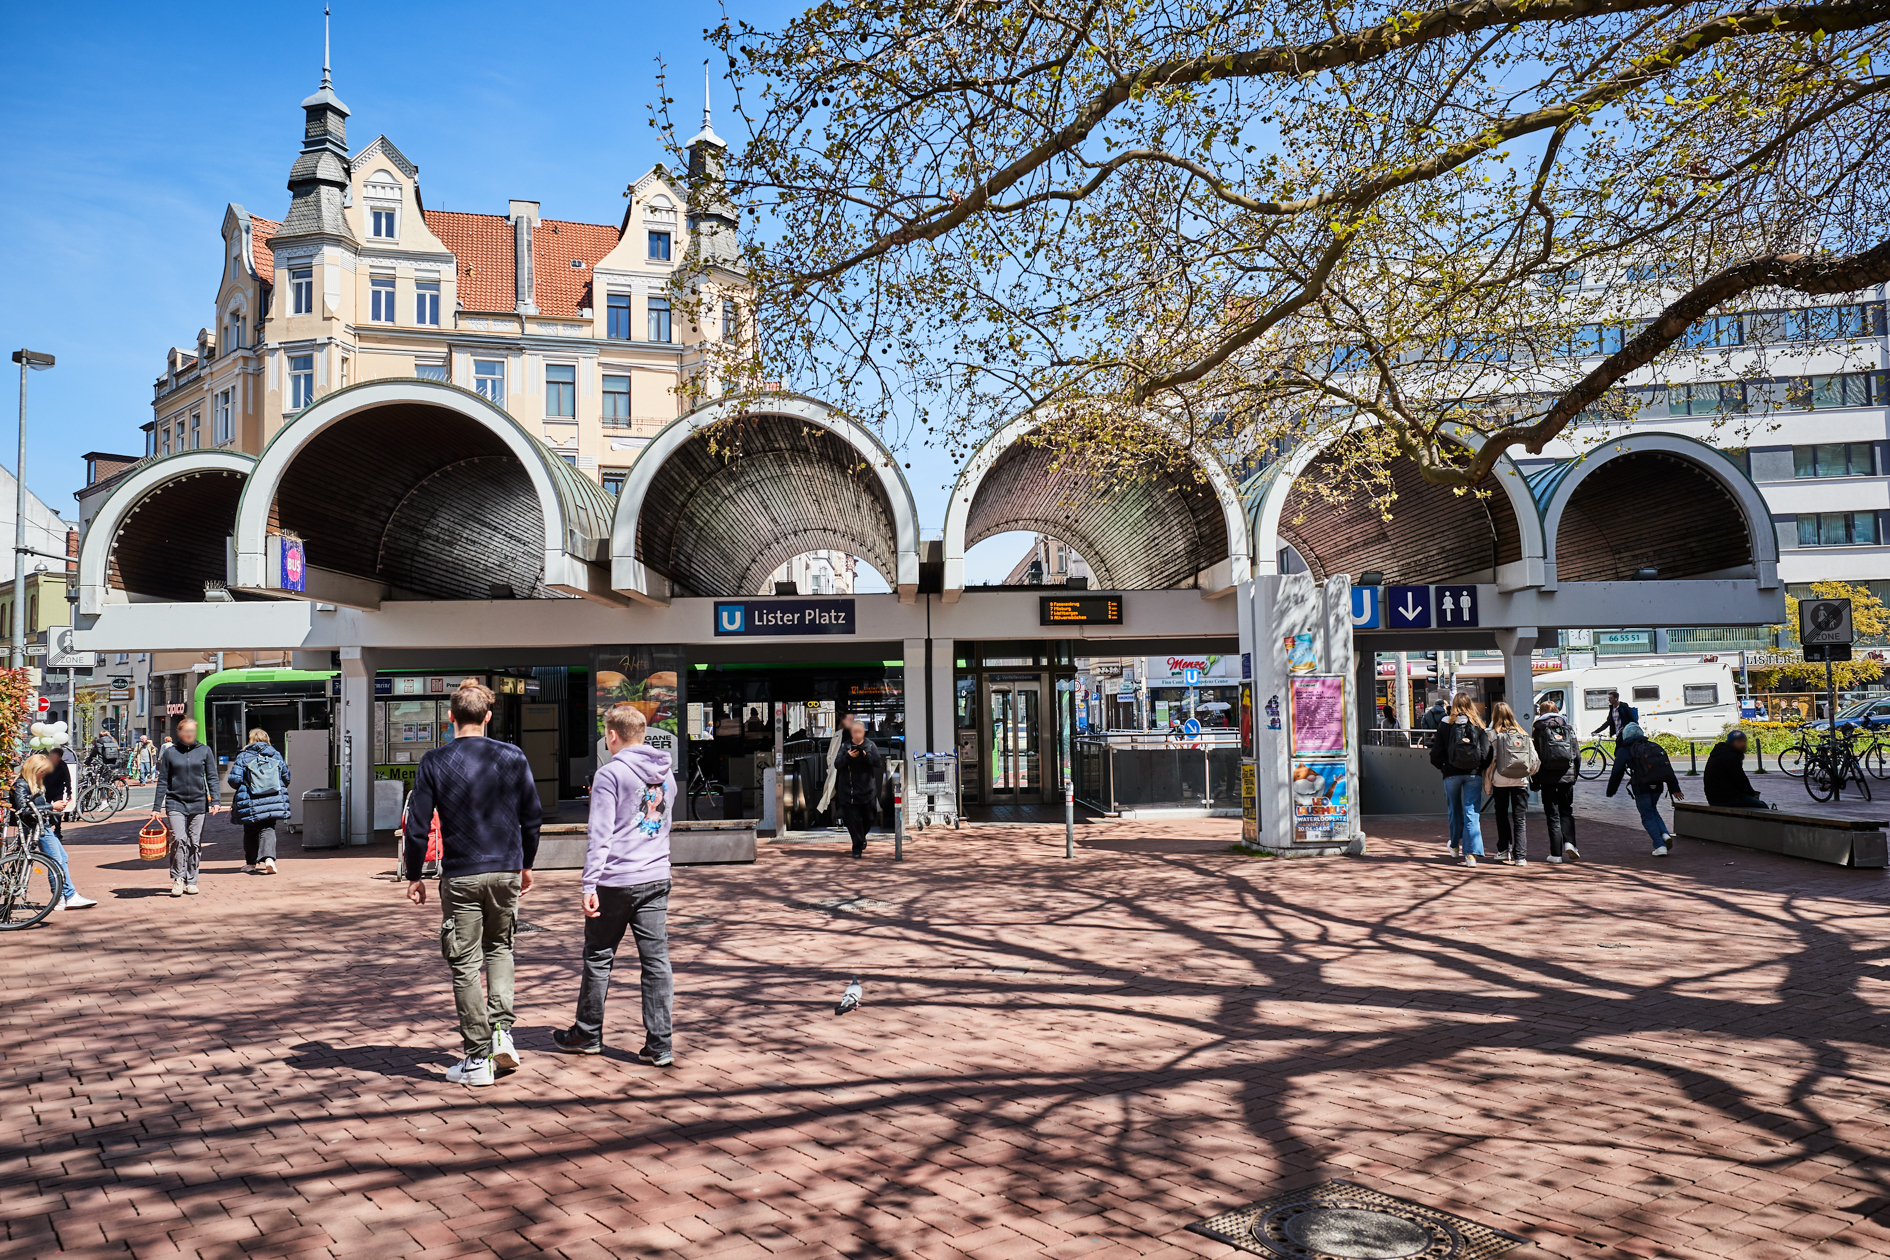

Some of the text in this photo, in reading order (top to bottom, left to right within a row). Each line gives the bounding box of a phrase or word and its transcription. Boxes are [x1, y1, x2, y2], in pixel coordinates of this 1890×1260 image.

[288, 558, 300, 572] BUS
[722, 611, 741, 630] U
[754, 608, 846, 626] Lister Platz
[1816, 632, 1840, 640] ZONE
[1166, 656, 1207, 671] Menze
[1186, 670, 1197, 683] U
[166, 700, 185, 717] tipico
[390, 768, 416, 779] Men
[1312, 798, 1329, 806] LEO
[1296, 806, 1347, 815] LAUSEMAUS
